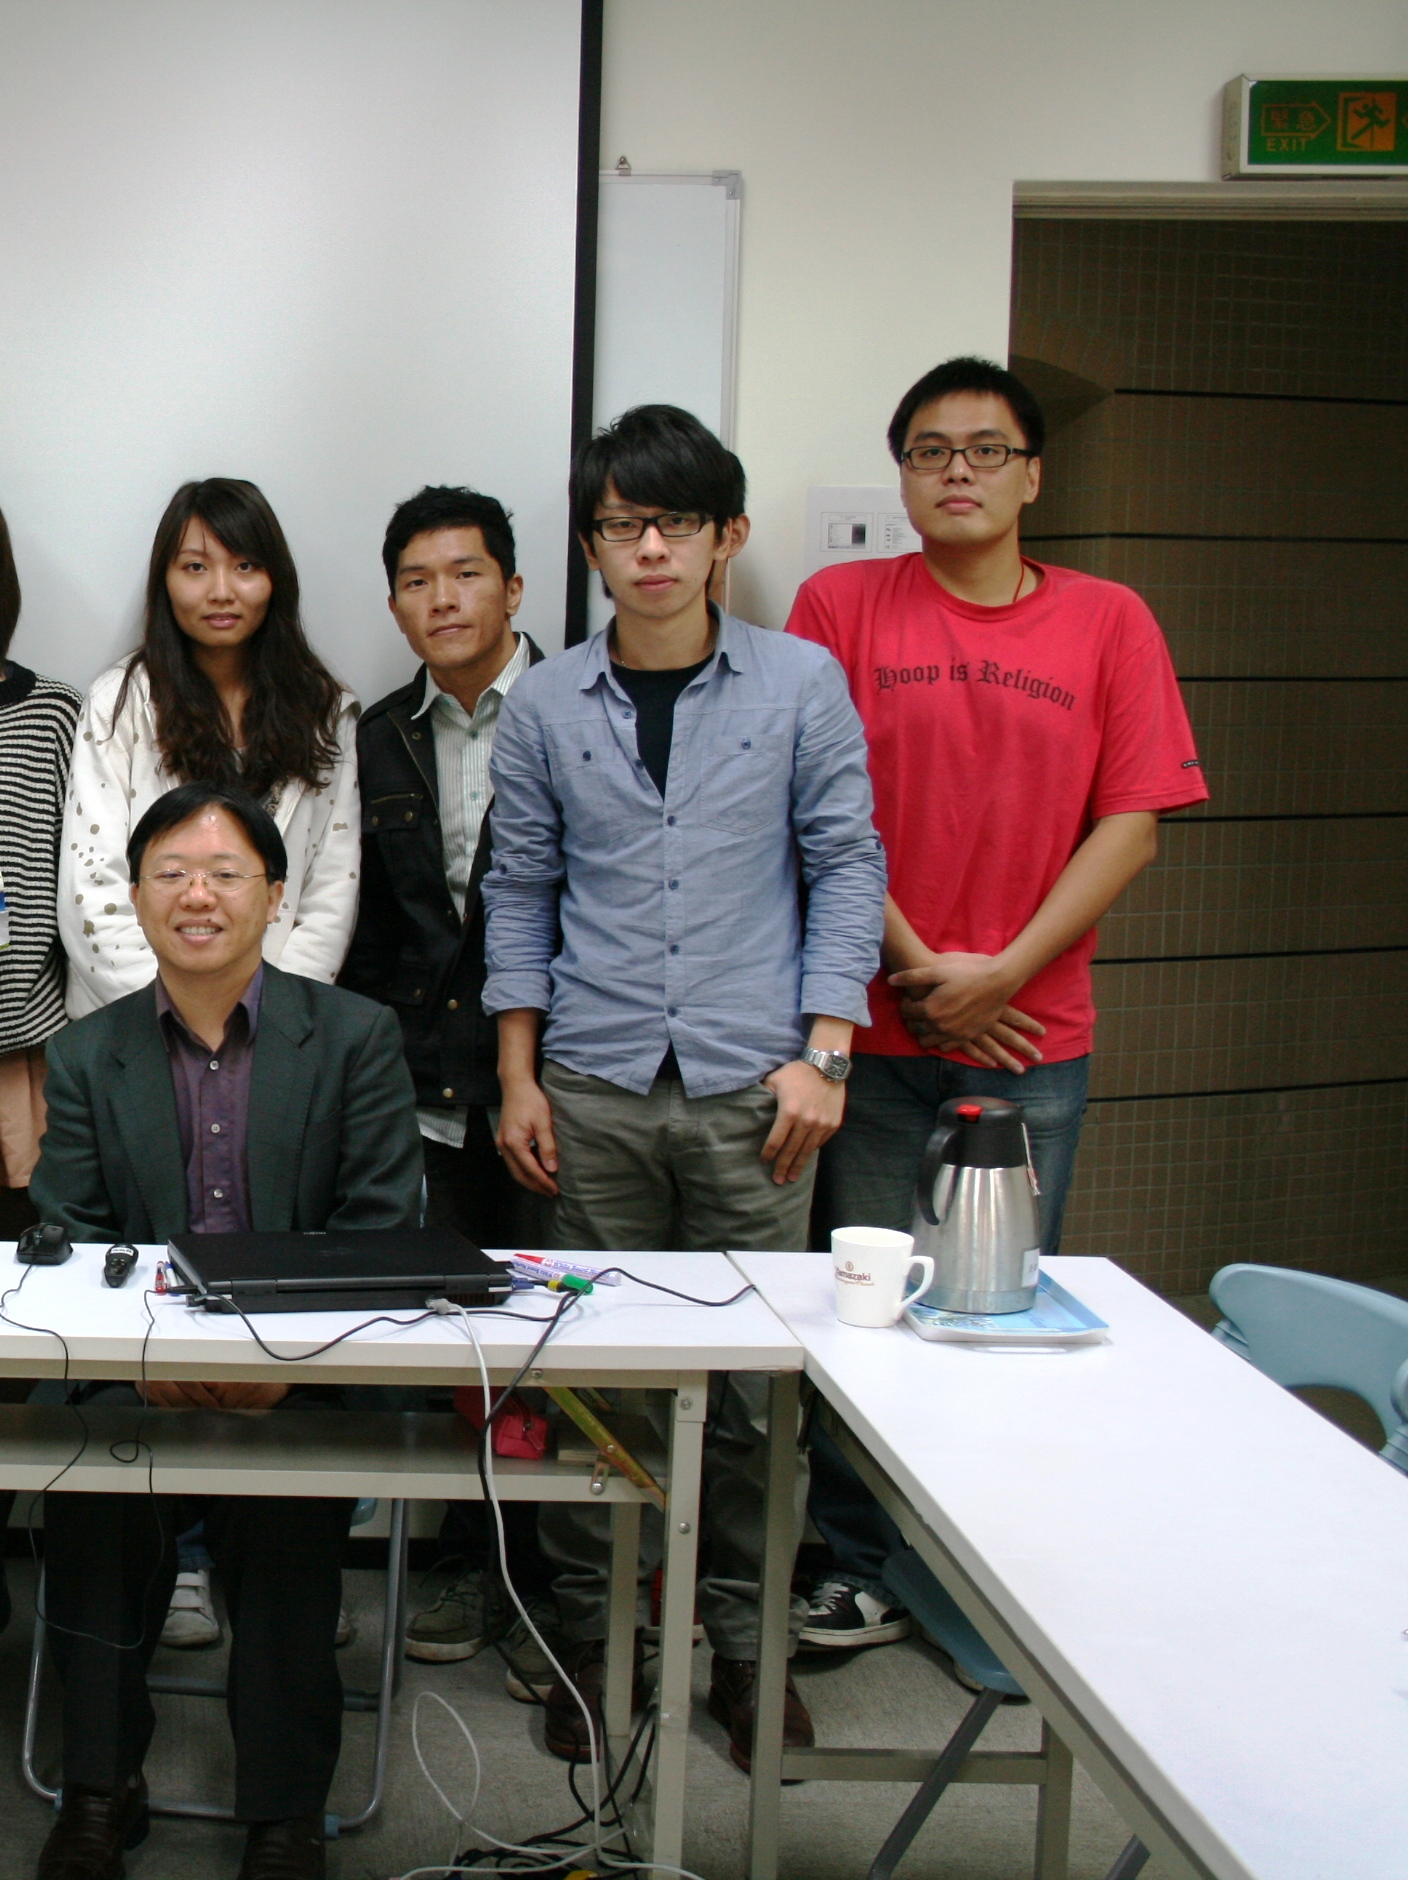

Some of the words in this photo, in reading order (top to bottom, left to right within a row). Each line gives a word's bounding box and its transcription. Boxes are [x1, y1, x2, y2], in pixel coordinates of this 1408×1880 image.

[1267, 138, 1308, 152] EXIT
[874, 664, 940, 695] Hoop
[949, 657, 970, 682] is
[976, 660, 1077, 710] Religion
